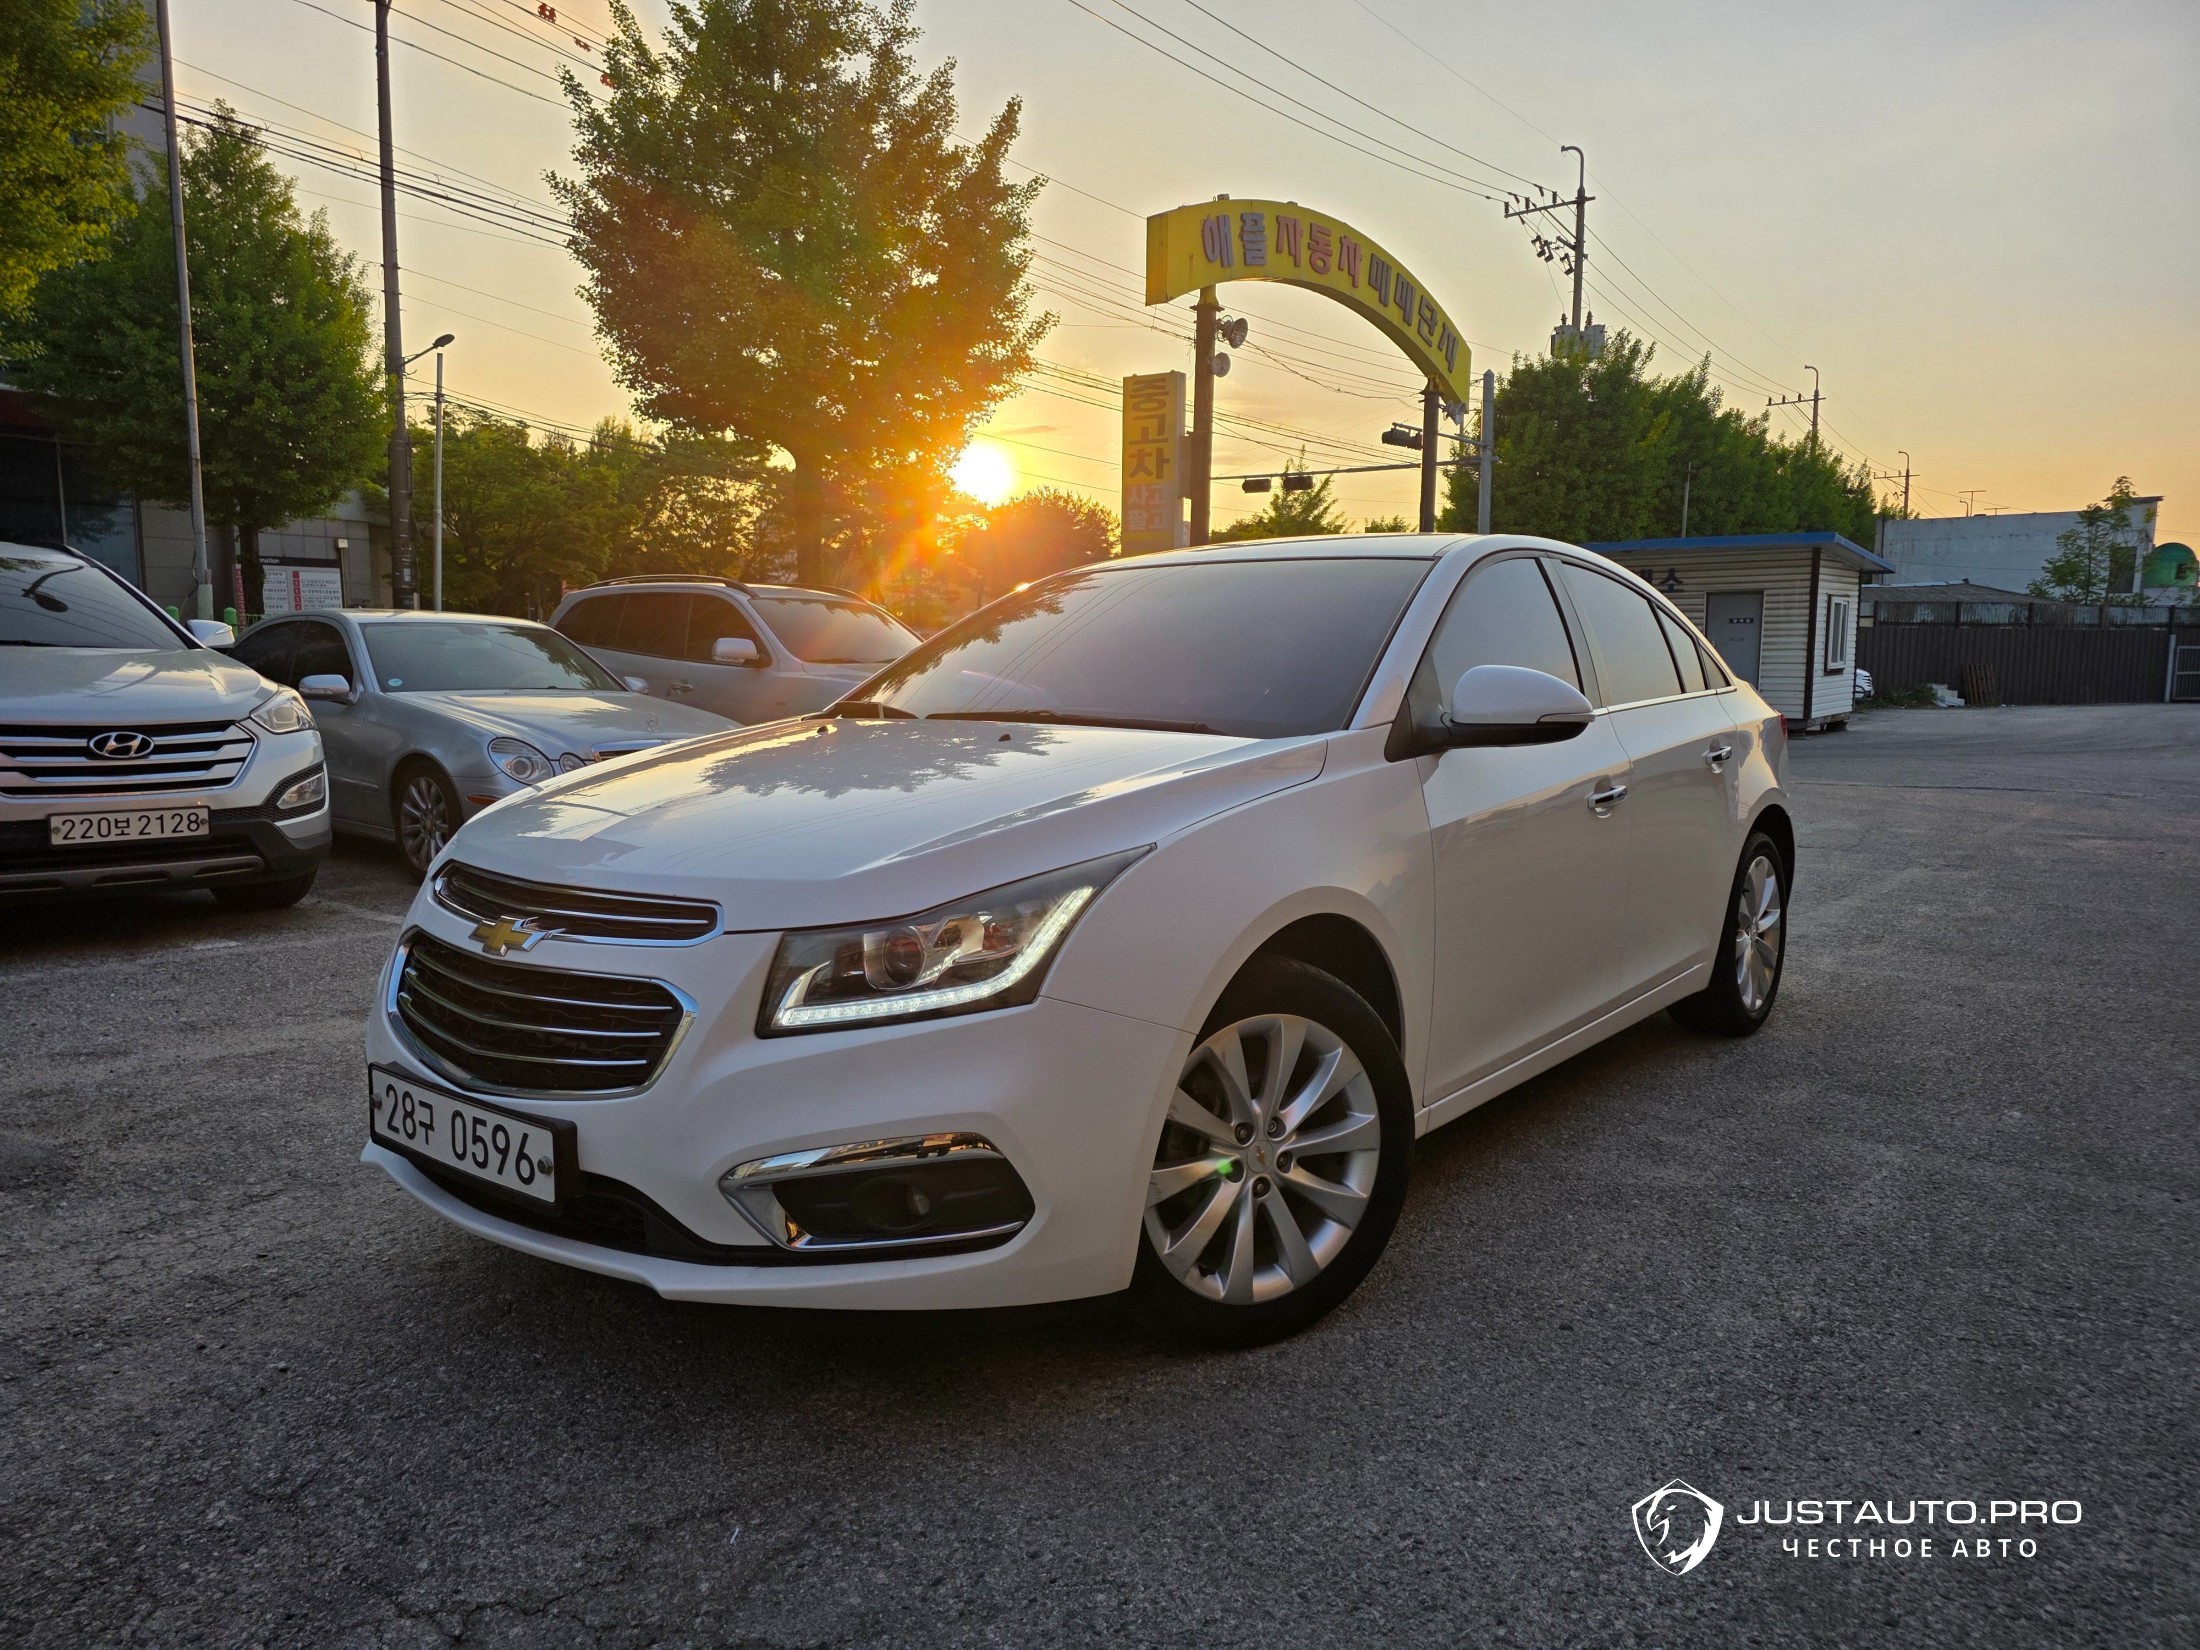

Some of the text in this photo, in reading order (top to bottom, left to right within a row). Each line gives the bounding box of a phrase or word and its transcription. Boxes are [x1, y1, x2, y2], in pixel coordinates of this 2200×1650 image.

[1203, 212, 1460, 374] 애플 자동차 매매단지
[1129, 377, 1170, 480] 중고차
[61, 812, 200, 841] 220보 2128
[386, 1083, 535, 1185] 28구 0596
